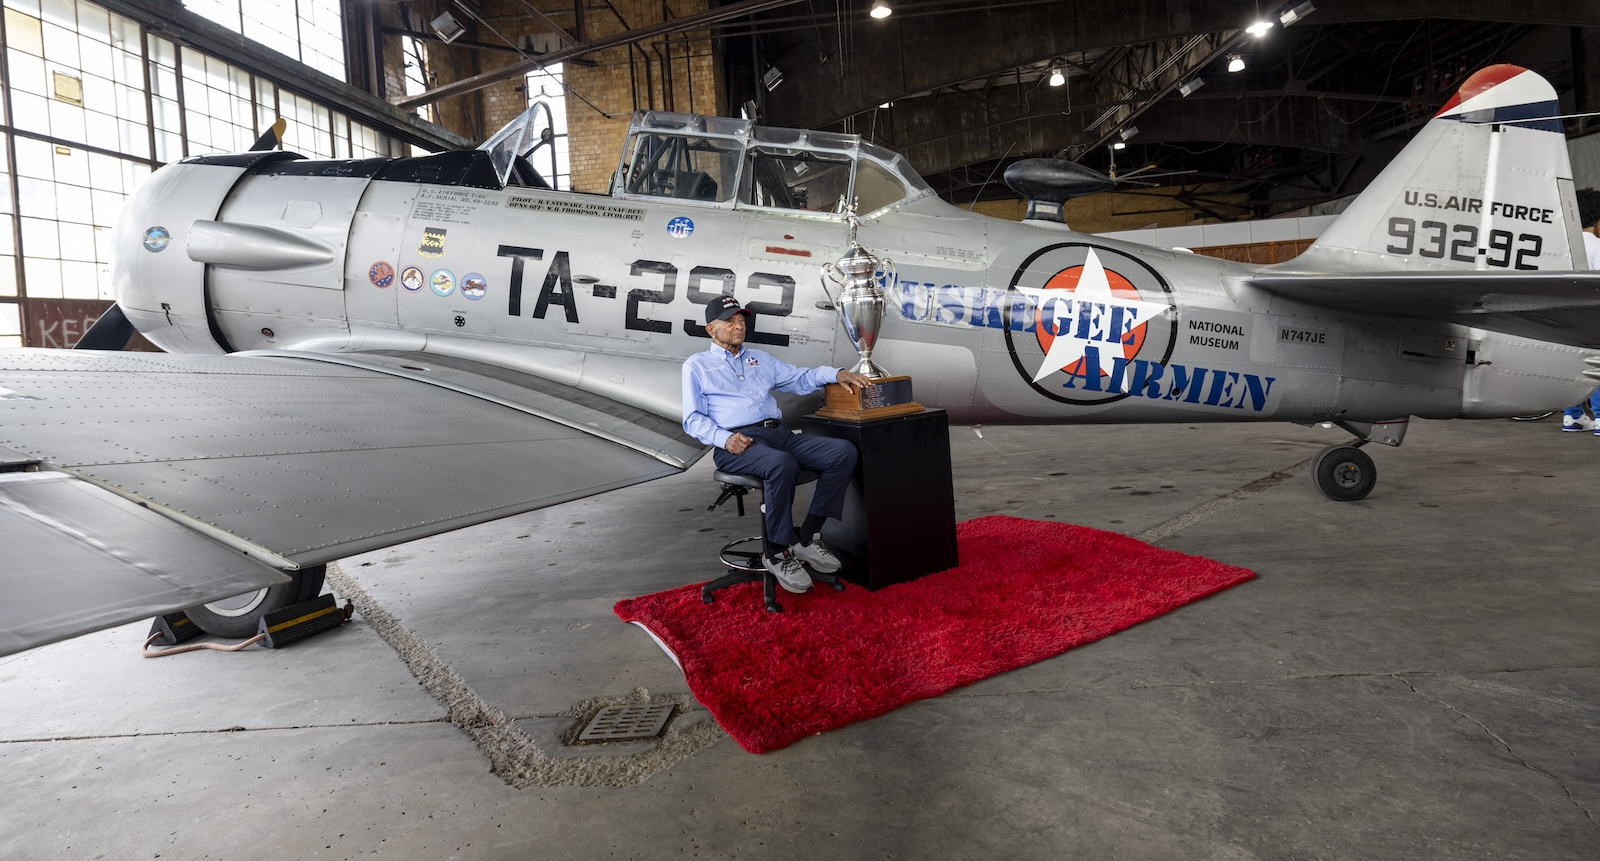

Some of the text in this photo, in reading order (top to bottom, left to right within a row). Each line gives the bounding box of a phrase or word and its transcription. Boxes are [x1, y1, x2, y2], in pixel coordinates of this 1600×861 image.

[1490, 201, 1554, 224] FORCE
[497, 244, 796, 347] TA-292
[1188, 319, 1245, 337] NATIONAL
[1281, 329, 1326, 344] N747JE
[1189, 335, 1239, 351] MUSEUM
[1063, 345, 1276, 412] AIRMEN
